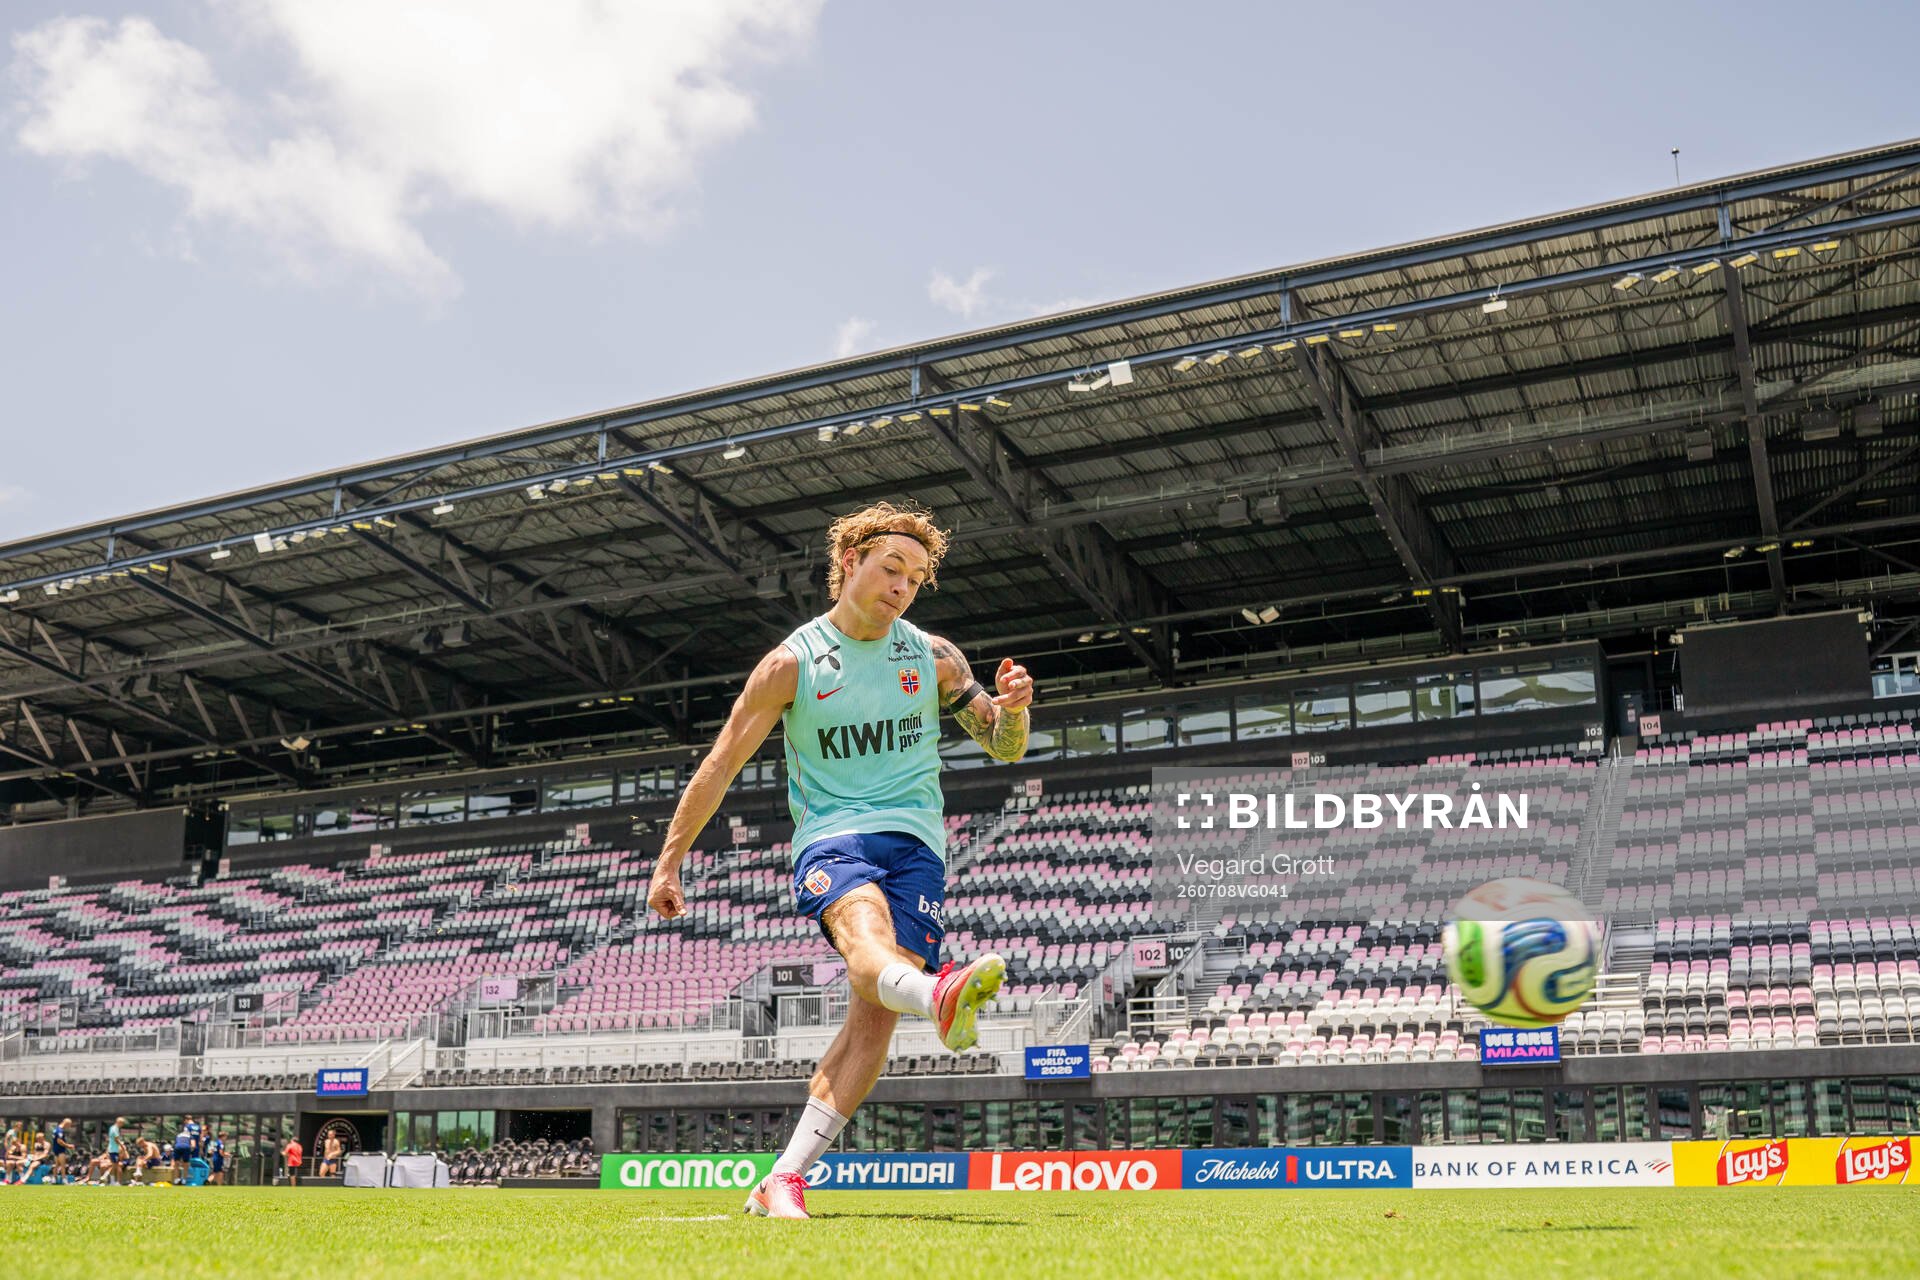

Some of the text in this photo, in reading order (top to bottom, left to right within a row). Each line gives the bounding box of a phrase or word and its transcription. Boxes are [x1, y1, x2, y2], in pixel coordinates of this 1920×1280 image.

[1585, 727, 1603, 737] 103
[1642, 721, 1659, 731] 104
[818, 711, 923, 760] KIWI mini
[898, 731, 923, 753] pris
[1294, 757, 1308, 766] 102
[1310, 755, 1326, 764] 103
[748, 829, 760, 838] 101
[1140, 948, 1162, 961] 102
[776, 969, 794, 982] 101
[485, 985, 500, 995] 132
[238, 997, 251, 1009] 131
[1485, 1031, 1554, 1047] WE ARE
[1047, 1048, 1067, 1058] FIFA
[1486, 1045, 1555, 1059] MIAMI
[1031, 1056, 1084, 1067] WORLD CUP
[1041, 1065, 1073, 1076] 2026
[322, 1082, 362, 1092] MIAMI
[1414, 1158, 1640, 1177] BANK OF AMERICA
[1725, 1143, 1783, 1185] Lay's
[1844, 1141, 1906, 1183] Lay's
[620, 1159, 757, 1188] aramco
[836, 1162, 955, 1184] HYUNDAI
[990, 1153, 1158, 1191] Lenovo
[1194, 1158, 1394, 1184] Michelob ULTRA
